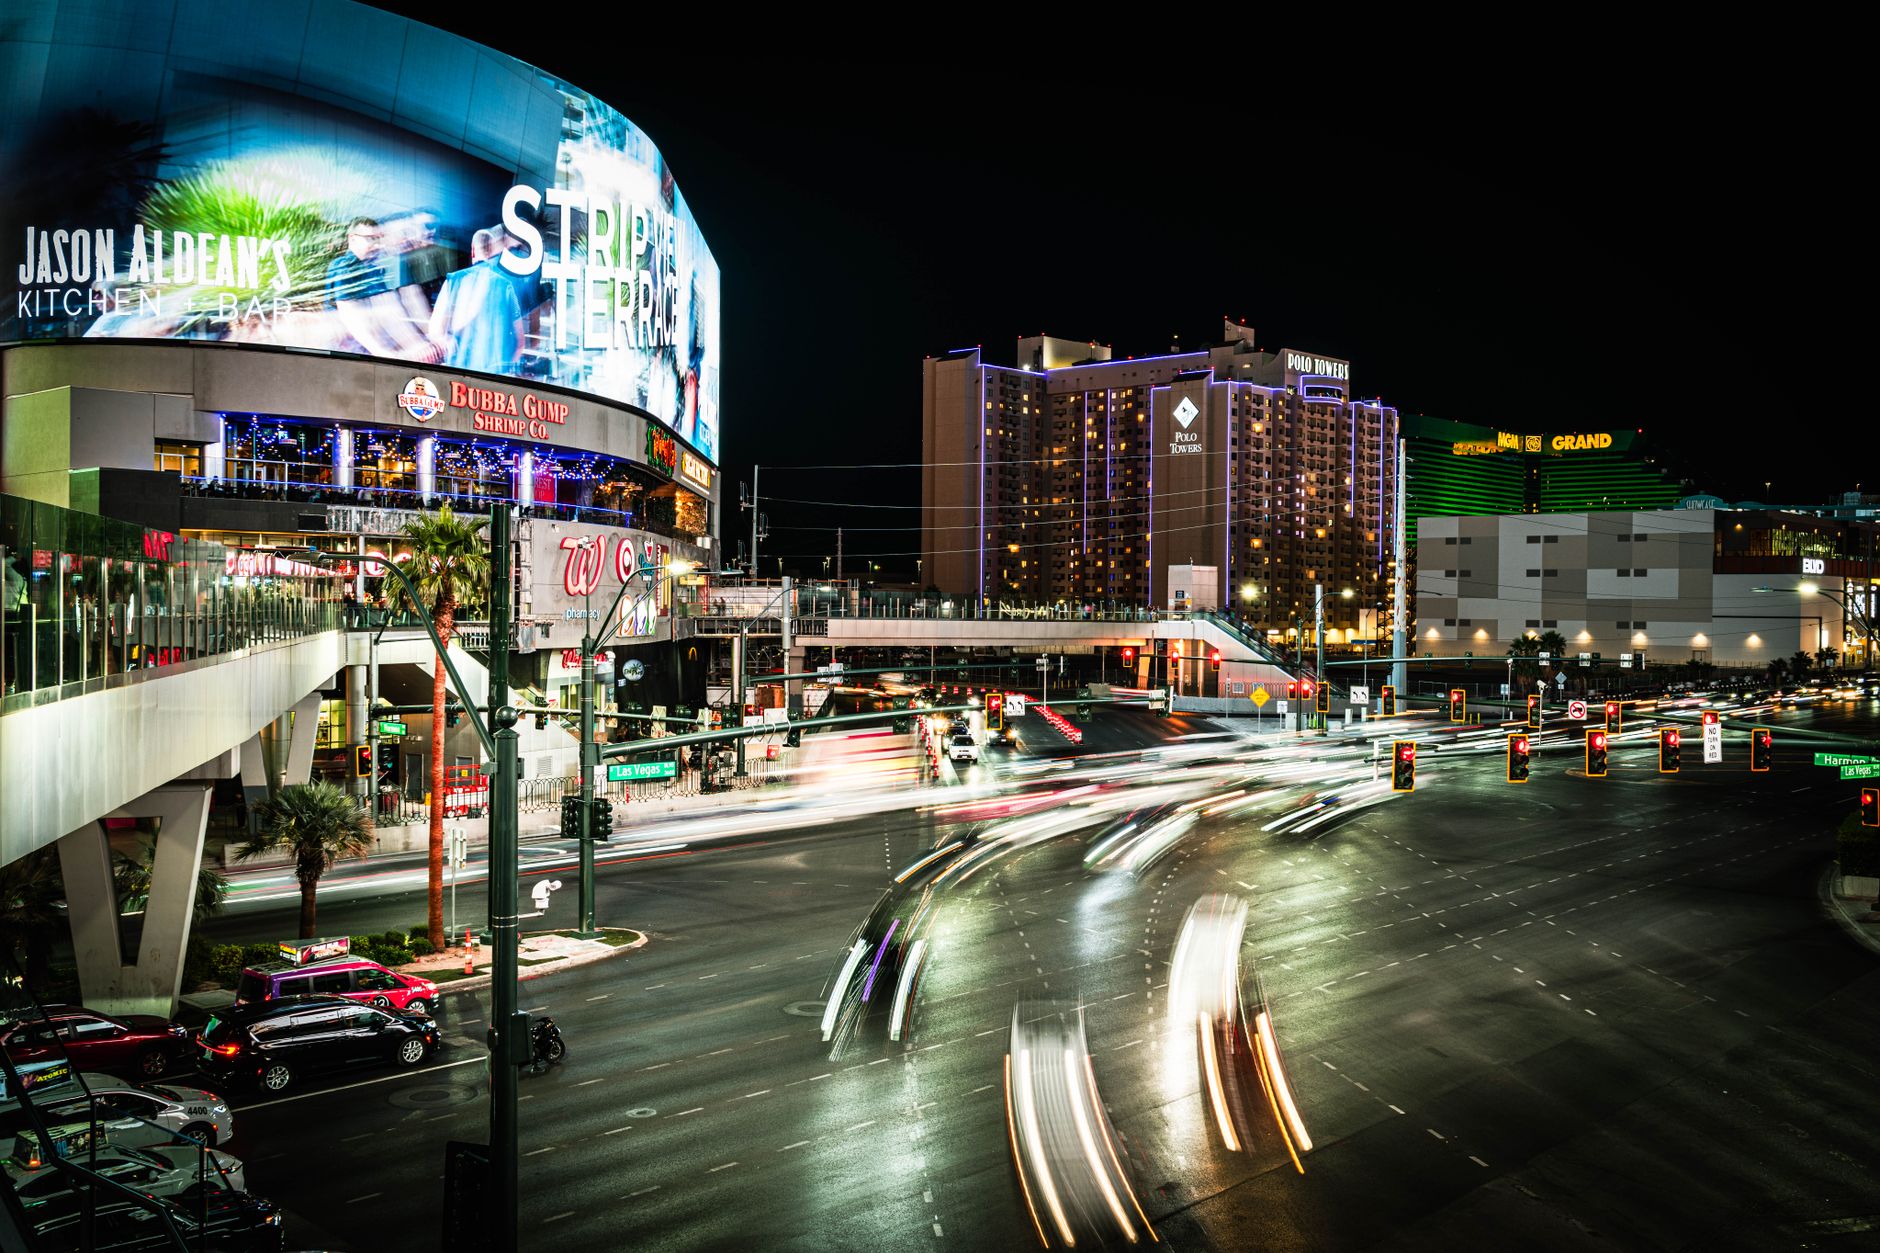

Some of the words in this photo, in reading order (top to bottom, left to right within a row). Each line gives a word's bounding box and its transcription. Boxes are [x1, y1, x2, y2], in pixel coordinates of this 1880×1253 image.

[499, 184, 648, 276] STRIP
[18, 226, 115, 285] JASON
[128, 224, 291, 292] ALDEAN'S
[18, 288, 161, 318] KITCHEN
[218, 292, 292, 322] BAR
[541, 262, 679, 350] TERRACE
[1287, 352, 1313, 373] POLO
[1314, 358, 1349, 380] TOWERS
[399, 395, 423, 405] BUBBA
[450, 381, 519, 416] BUBBA
[523, 393, 569, 425] GUMP
[473, 411, 527, 437] SHRIMP
[529, 420, 549, 440] CO.
[1175, 432, 1198, 442] POLO
[1497, 431, 1519, 450] MGM
[1551, 433, 1613, 451] GRAND
[1170, 443, 1203, 454] TOWERS
[565, 608, 601, 620] pharmacy
[1708, 727, 1717, 735] NO
[1824, 755, 1866, 765] Harmon
[616, 765, 633, 777] Las
[633, 763, 661, 778] Vegas
[1845, 765, 1855, 776] Las
[1855, 765, 1872, 778] Vegas
[36, 1068, 68, 1083] ATOMIC
[187, 1106, 208, 1115] 4400
